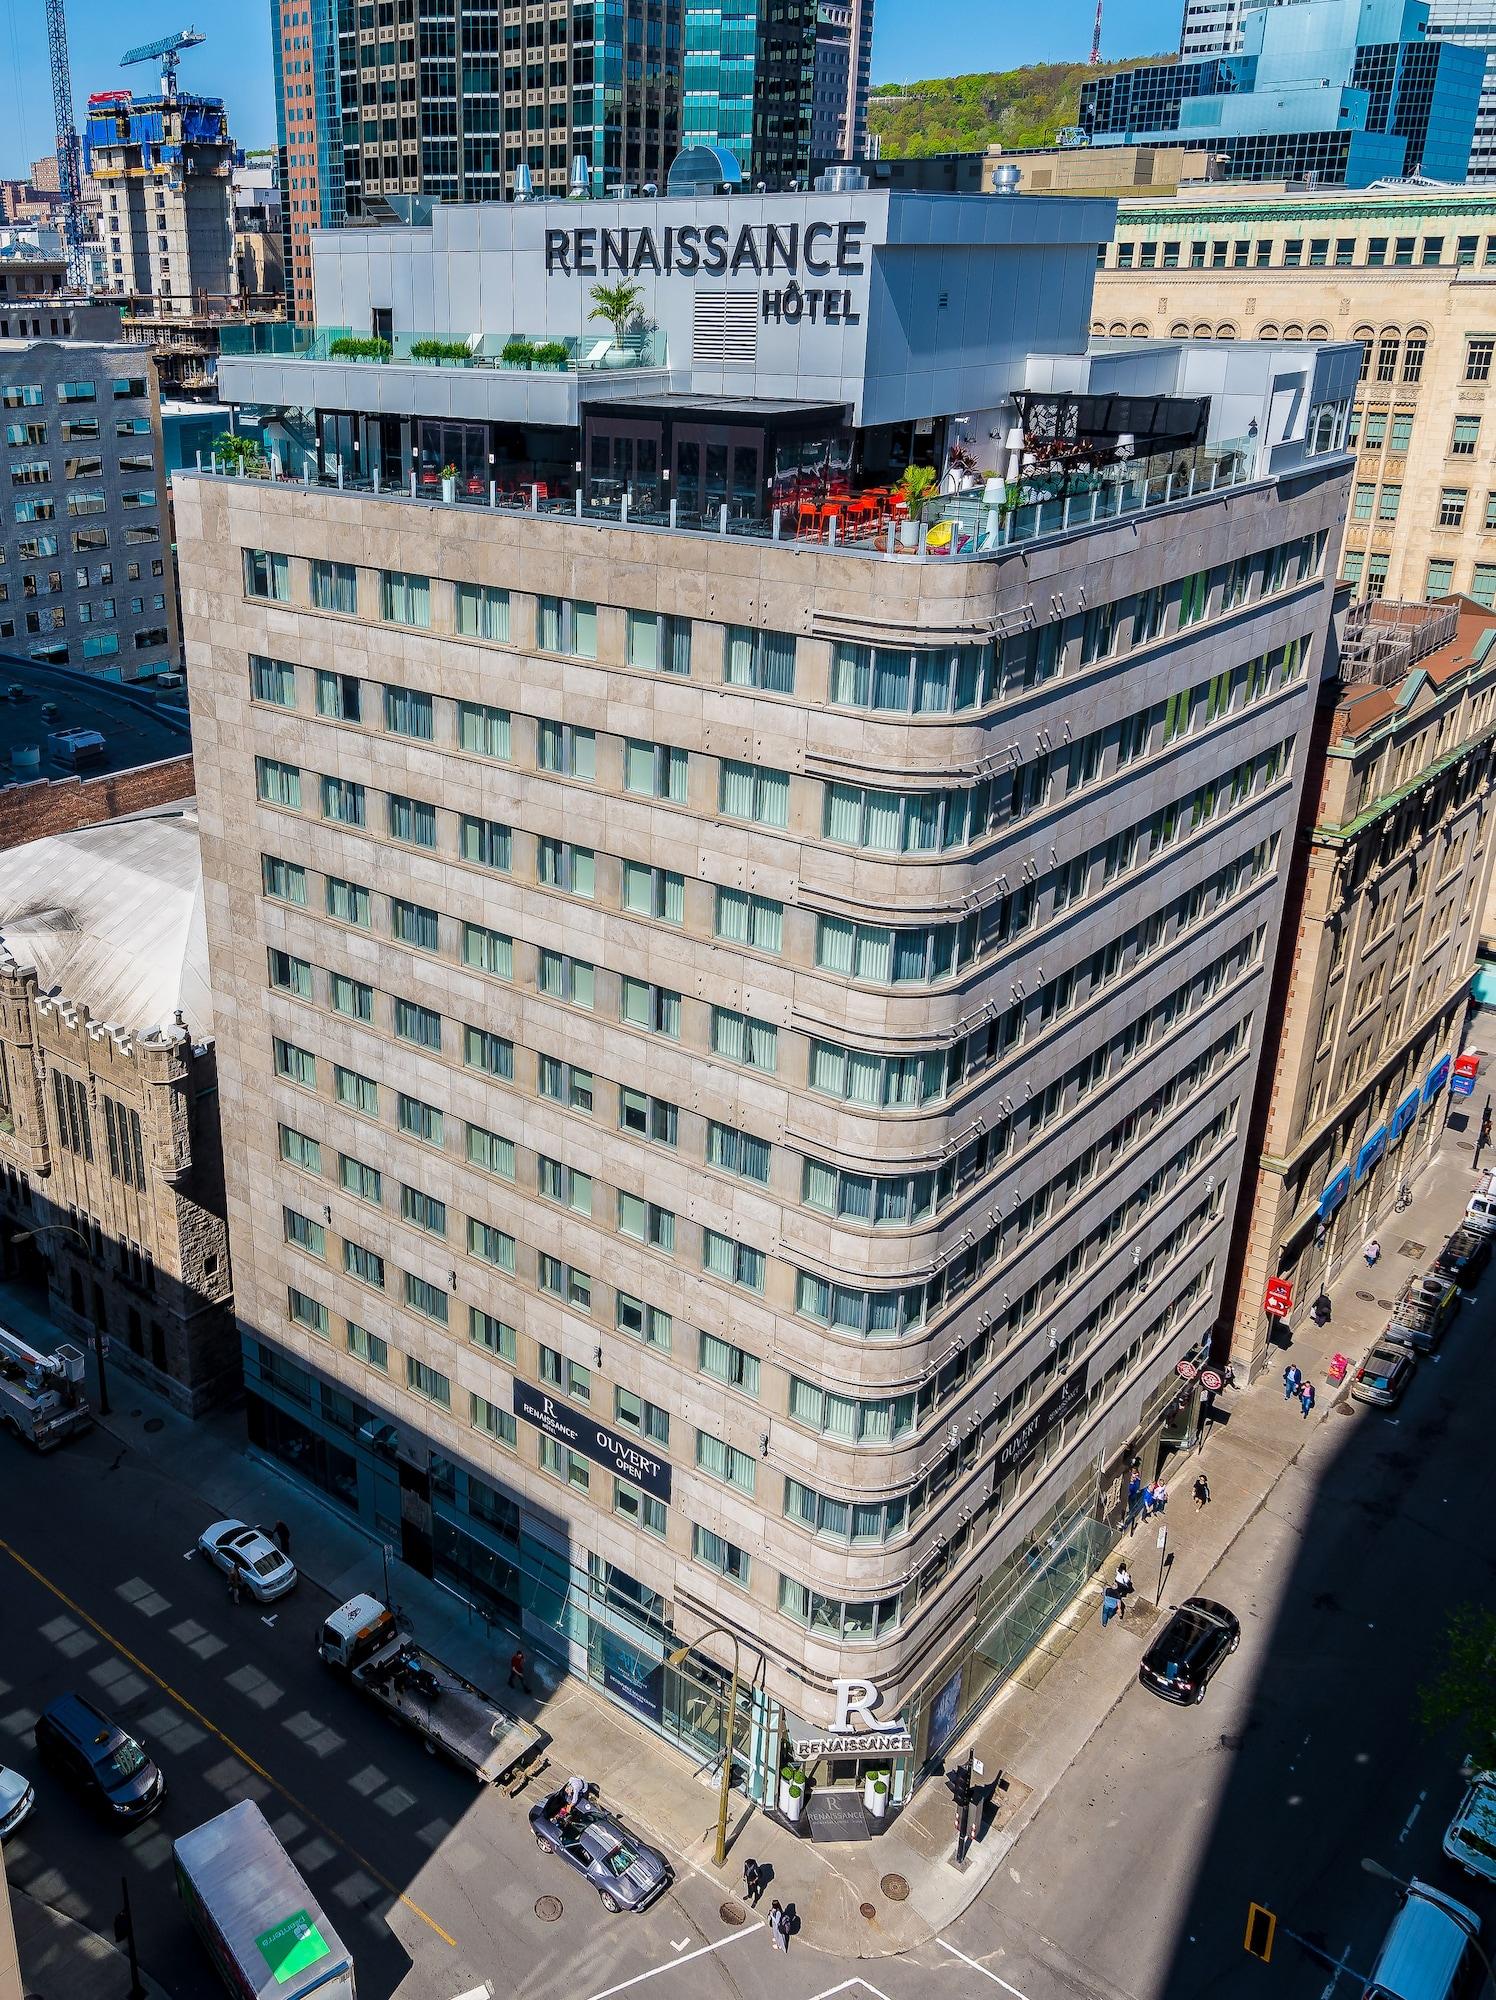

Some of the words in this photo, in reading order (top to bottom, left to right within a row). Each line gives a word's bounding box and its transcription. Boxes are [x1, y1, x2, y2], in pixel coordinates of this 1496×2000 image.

[545, 221, 866, 270] RENAISSANCE
[762, 280, 860, 318] HÔTEL
[523, 1403, 577, 1440] RENAISSANCE
[543, 1396, 558, 1419] R
[596, 1432, 661, 1477] OUVERT
[1001, 1414, 1041, 1463] OUVERT
[615, 1459, 642, 1480] OPEN
[828, 1679, 897, 1732] R
[798, 1735, 912, 1754] RENAISSANCE
[808, 1811, 864, 1821] RENAISSANCE
[826, 1797, 842, 1811] R
